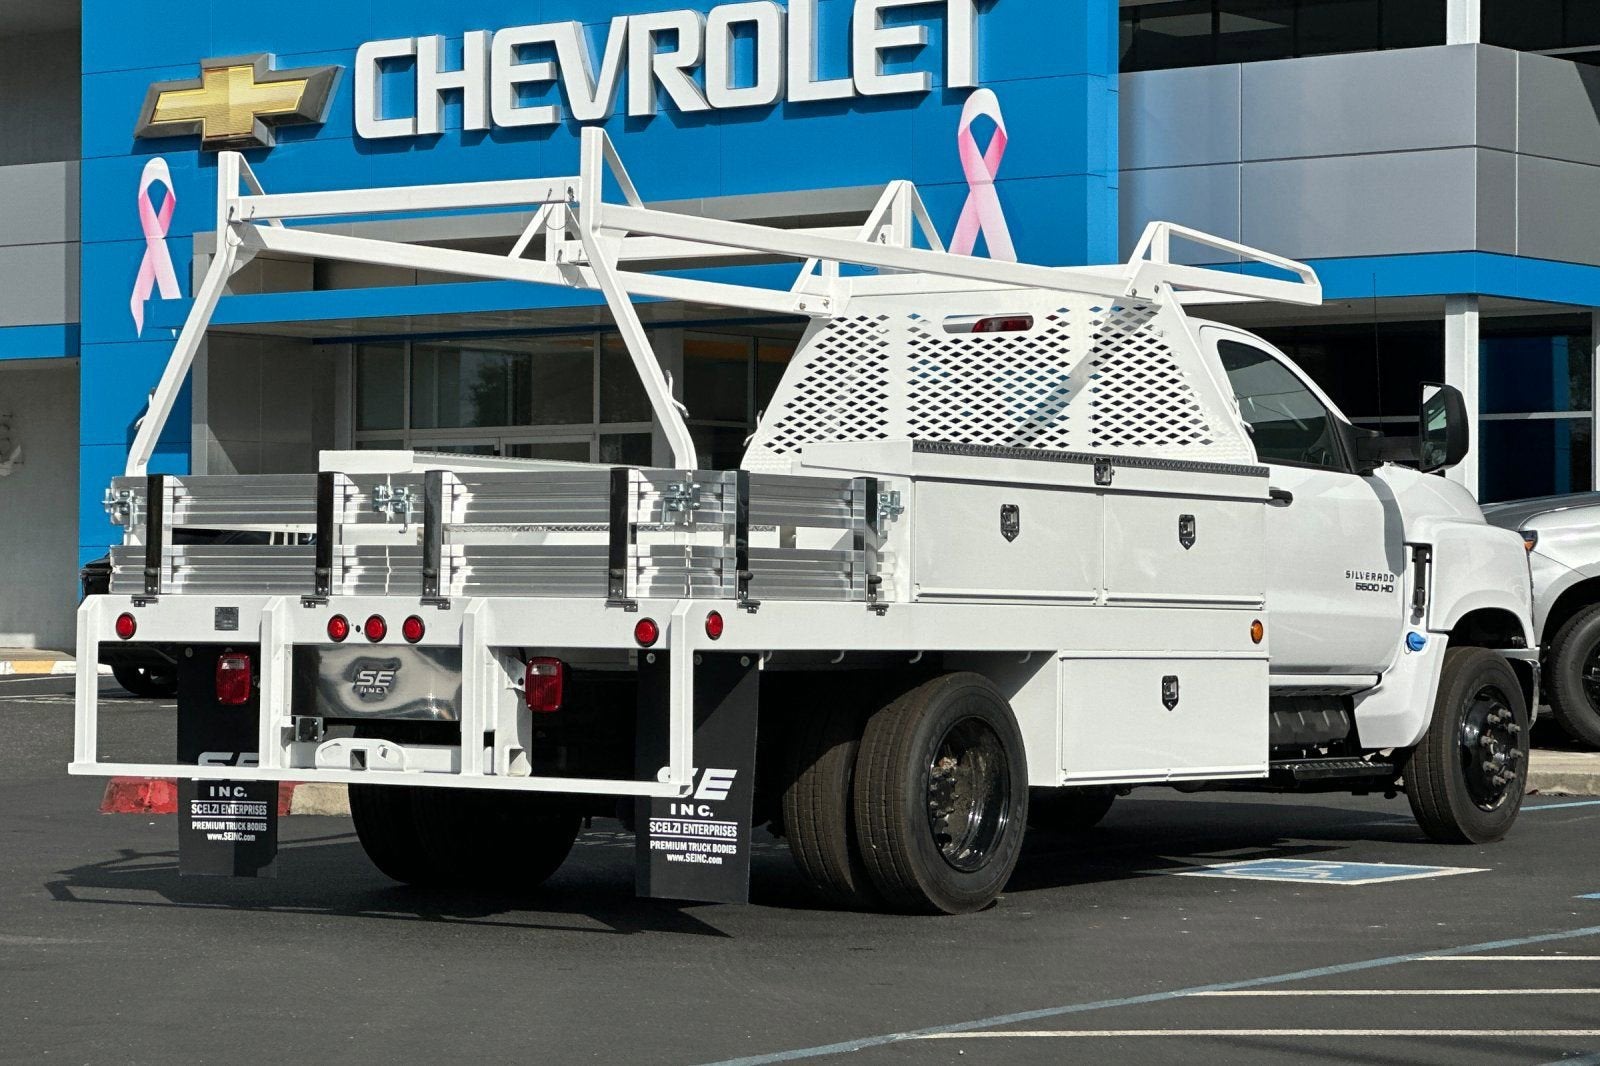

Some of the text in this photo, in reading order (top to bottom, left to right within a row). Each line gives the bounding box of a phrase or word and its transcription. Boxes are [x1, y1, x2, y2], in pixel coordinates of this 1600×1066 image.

[355, 0, 979, 138] CHEVROLET
[1346, 570, 1394, 582] SILVERADO
[1381, 584, 1394, 593] HD
[357, 670, 394, 686] SE
[209, 786, 248, 797] INC.
[191, 803, 267, 816] SCELZI ENTERPRISES
[670, 803, 714, 818] INC.
[191, 821, 267, 832] PREMIUM TRUCK BODIES
[650, 822, 737, 837] SCELZI ENTERPRISES
[207, 832, 256, 841] www.SEINC.com
[649, 840, 737, 855] PREMIUM TRUCK BODIES
[667, 854, 722, 865] www.SEINC.com
